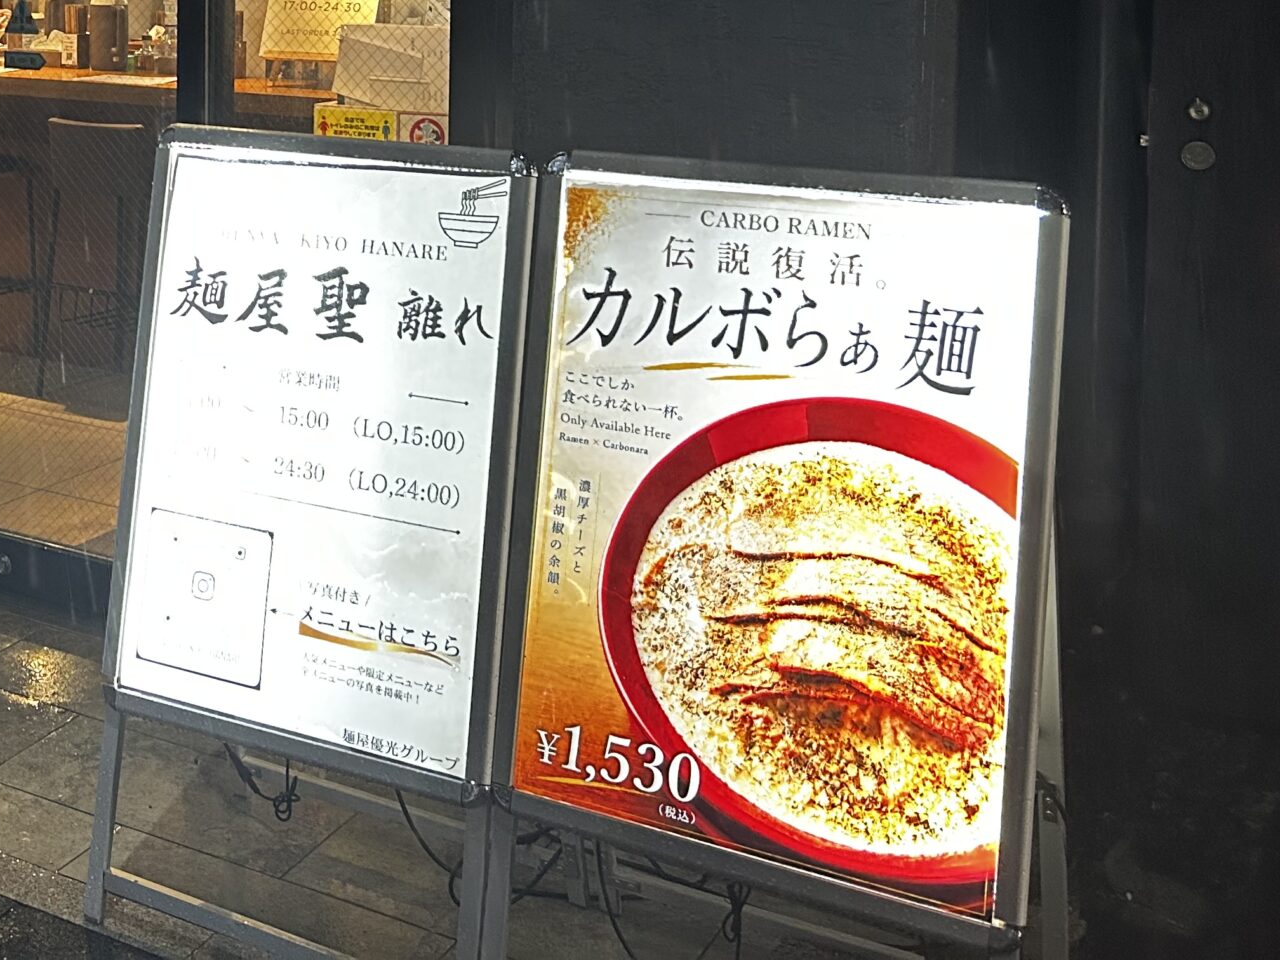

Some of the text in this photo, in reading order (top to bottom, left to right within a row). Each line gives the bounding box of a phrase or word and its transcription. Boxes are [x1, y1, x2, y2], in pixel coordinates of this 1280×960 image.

[283, 1, 361, 13] 17:00-24:30
[700, 209, 873, 241] CARBO RAMEN
[300, 234, 348, 252] KIYO
[361, 238, 448, 261] HANARE
[662, 235, 887, 291] 伝説復活。
[396, 288, 494, 346] 離れ
[565, 267, 985, 397] カルボらぁ麺
[278, 369, 340, 392] 営業時間
[565, 371, 635, 392] ここでしか
[279, 406, 329, 431] 15:00
[561, 388, 685, 423] 食べられない一杯。
[560, 412, 672, 440] Only Available Here
[559, 432, 590, 447] Ramen
[602, 439, 649, 456] Carbonara
[273, 456, 326, 483] 24:30
[573, 478, 591, 574] 濃厚チーズと
[547, 487, 568, 596] 黒胡椒の余韻。
[301, 605, 461, 658] メニューはこちら
[537, 725, 701, 804] ¥1,530
[658, 804, 696, 826] (税込)
